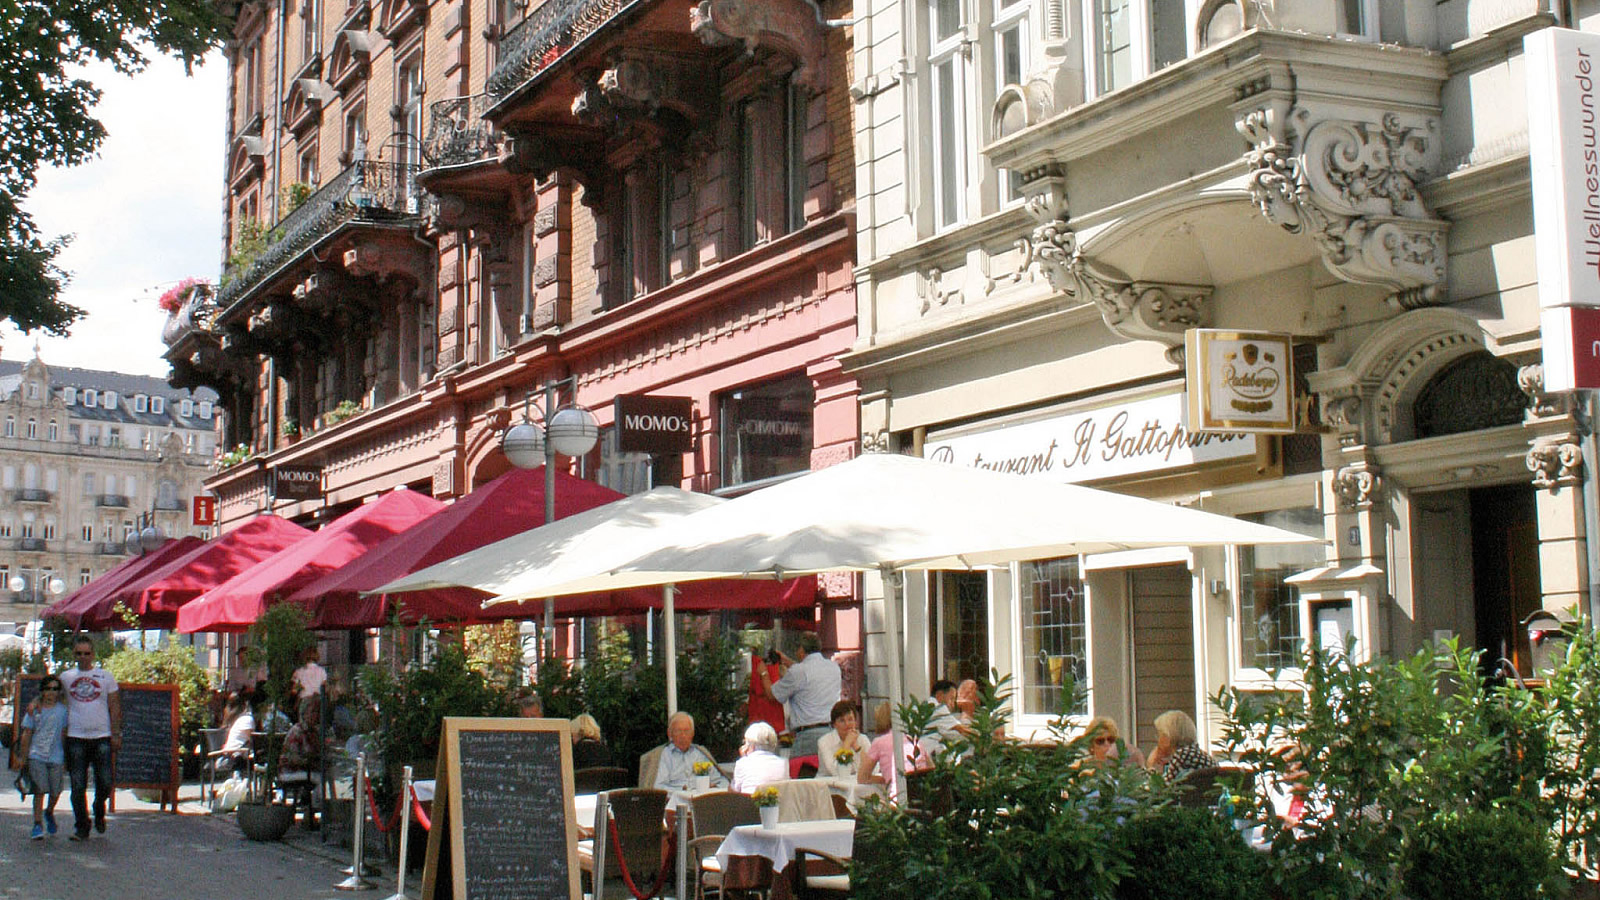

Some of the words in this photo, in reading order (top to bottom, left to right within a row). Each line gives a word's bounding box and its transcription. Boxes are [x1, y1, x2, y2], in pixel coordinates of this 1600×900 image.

[1575, 47, 1600, 267] Wellnesswunder
[625, 414, 689, 433] MOMO's
[1063, 417, 1096, 469] Il
